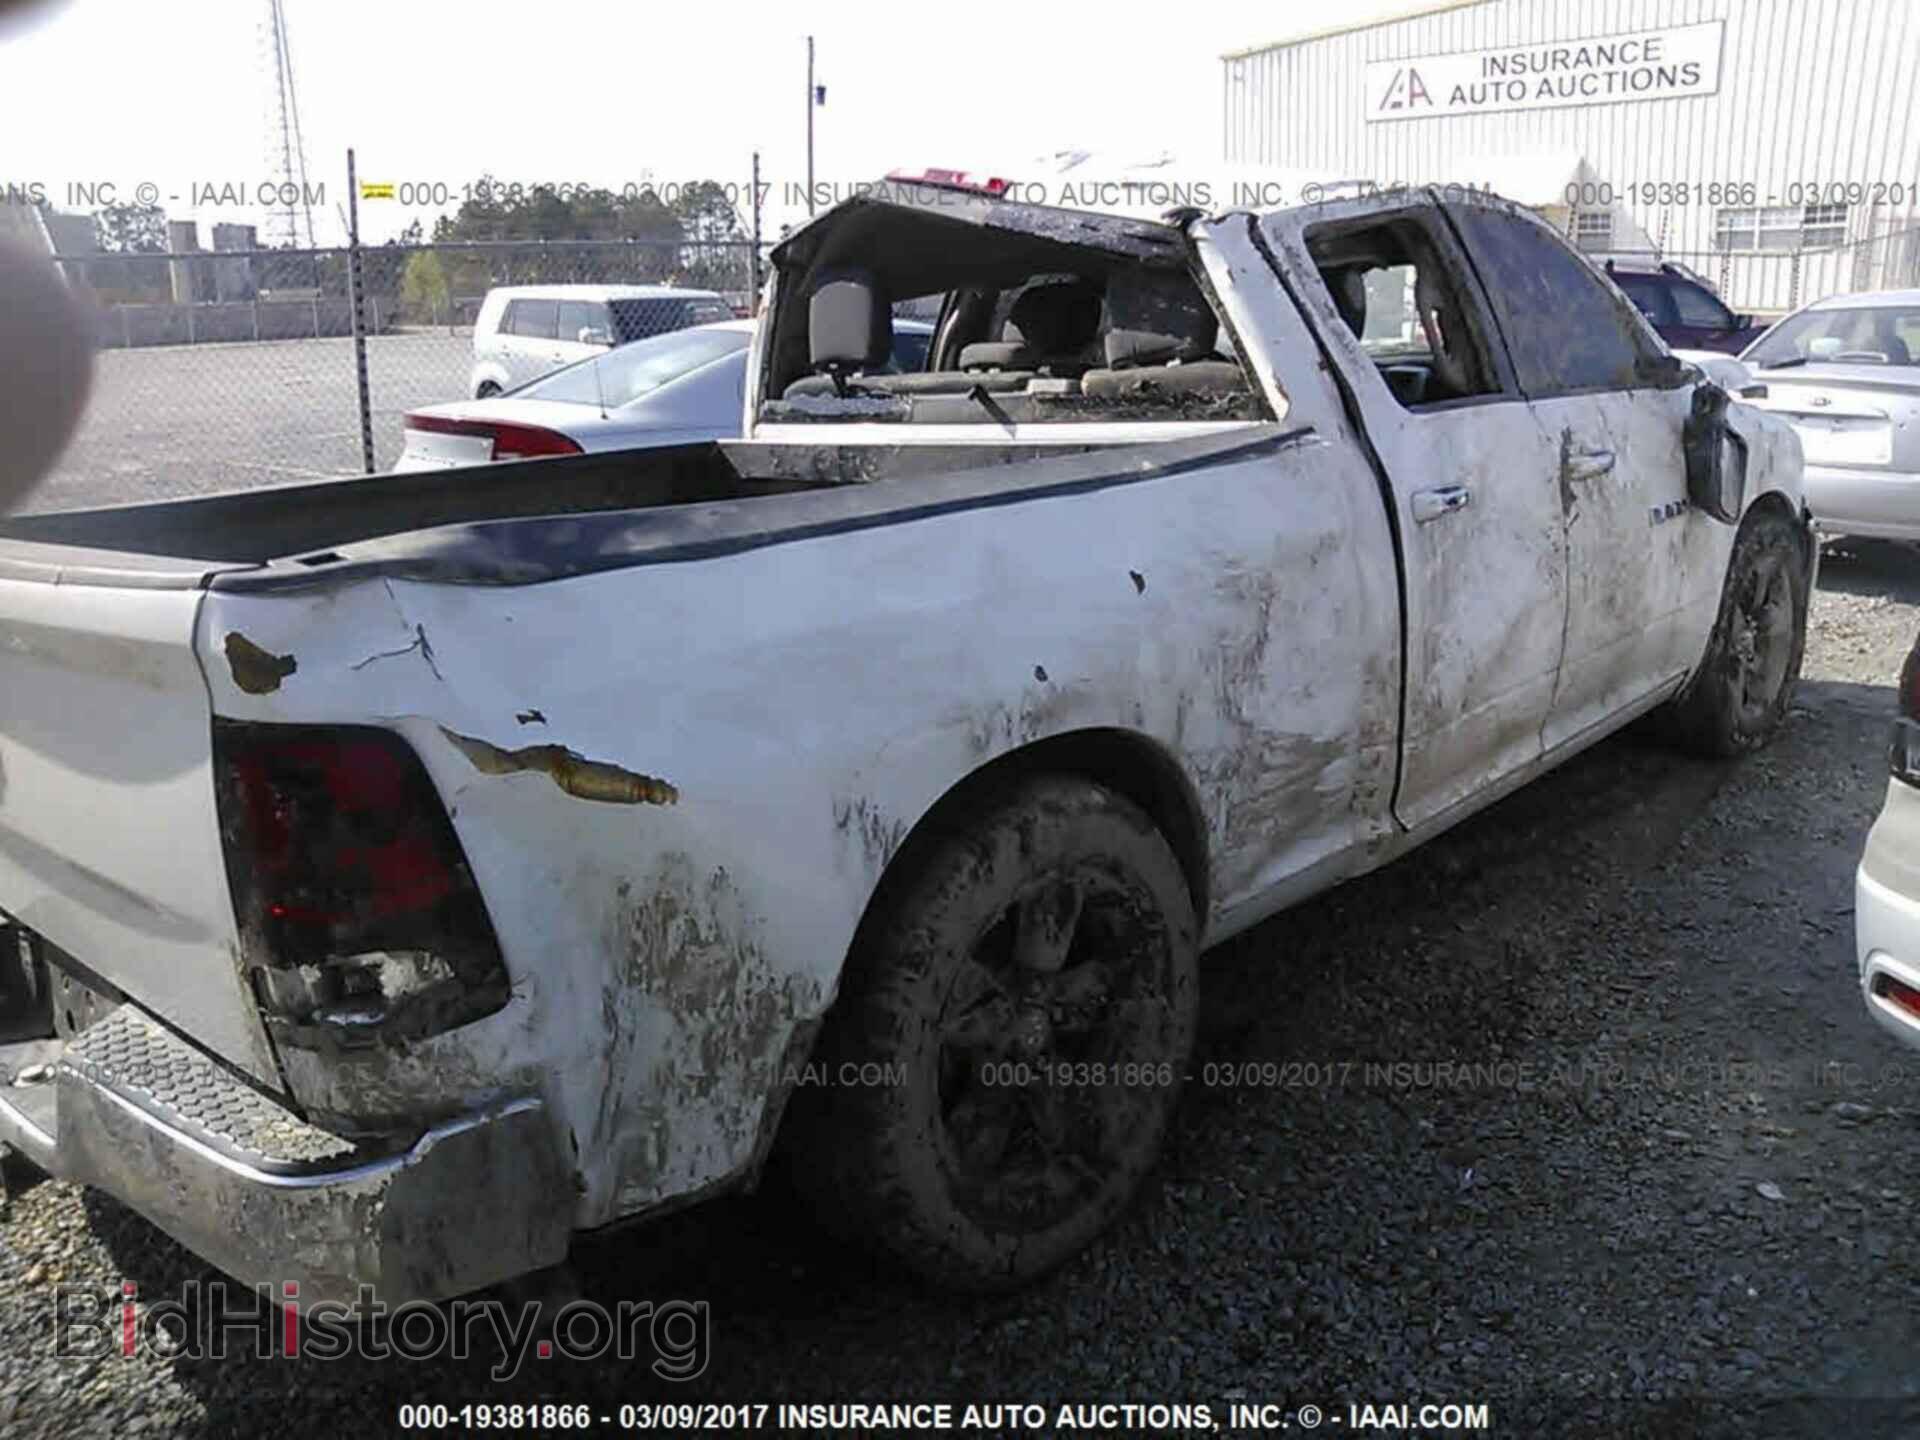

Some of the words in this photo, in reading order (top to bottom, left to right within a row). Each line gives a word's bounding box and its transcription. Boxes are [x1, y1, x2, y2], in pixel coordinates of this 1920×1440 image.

[1482, 37, 1664, 79] INSURANCE
[1449, 79, 1527, 106] AUTO
[1535, 61, 1701, 100] AUCTIONS
